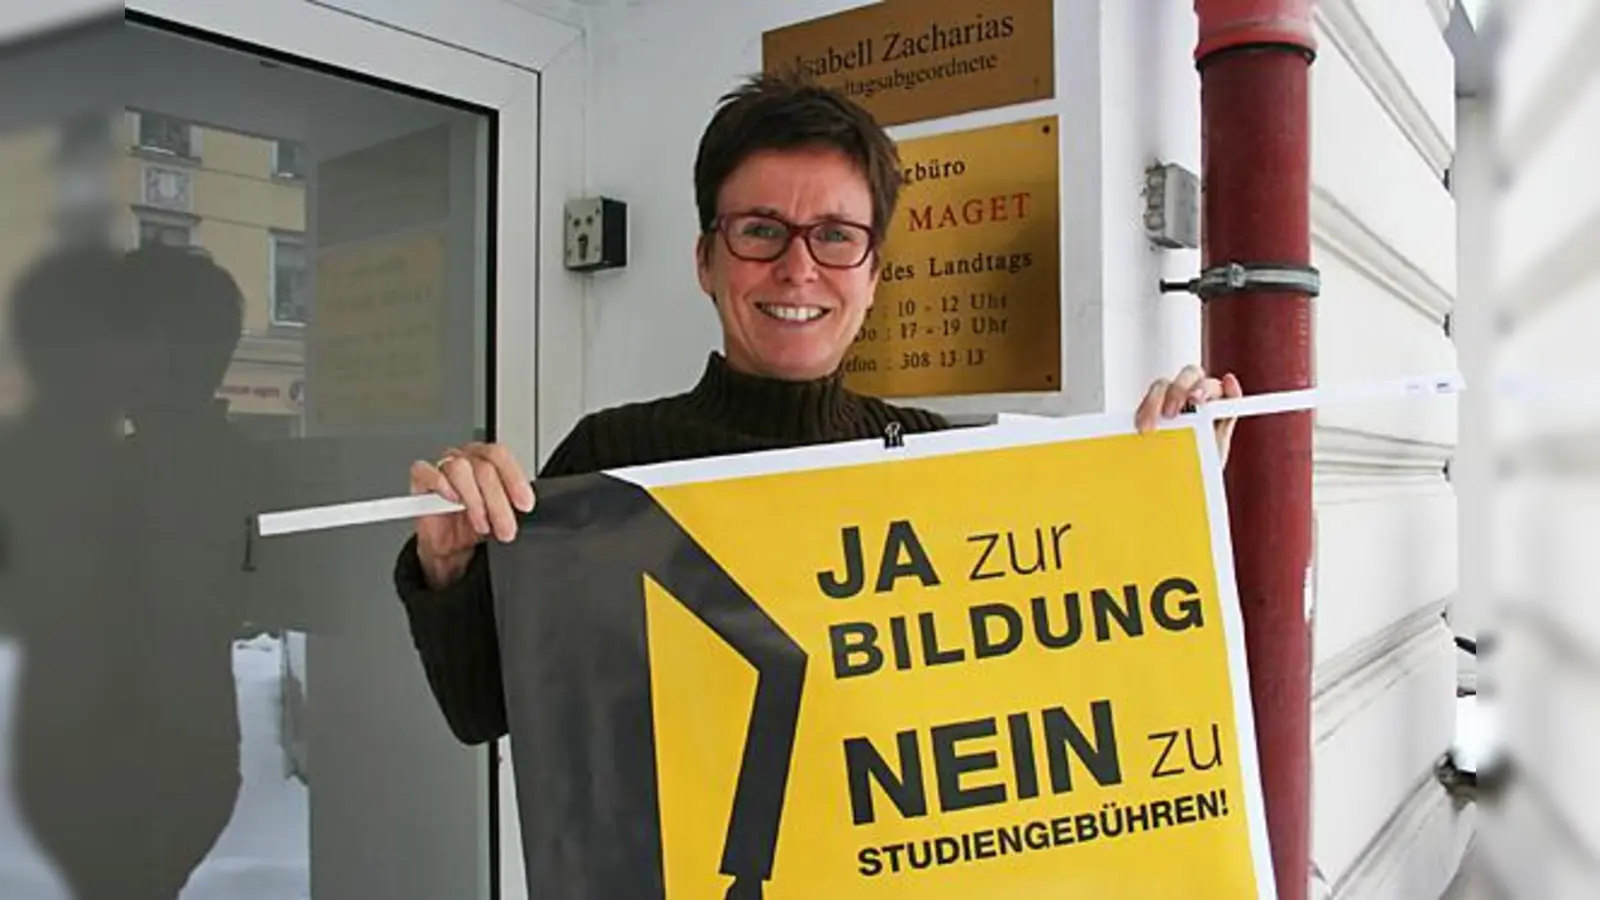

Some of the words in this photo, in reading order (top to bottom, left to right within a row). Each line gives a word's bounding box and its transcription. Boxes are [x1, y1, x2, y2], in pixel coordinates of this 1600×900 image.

[881, 14, 1014, 63] Zacharias
[908, 192, 1031, 232] MAGET
[881, 261, 915, 282] des
[929, 252, 1033, 278] Landtags
[898, 299, 916, 317] 10
[941, 295, 959, 313] 12
[970, 292, 1007, 311] Uhr
[901, 322, 918, 339] 17
[943, 318, 961, 336] 19
[971, 316, 1007, 335] Uhr
[900, 350, 931, 370] 308
[816, 519, 941, 599] JA
[967, 522, 1072, 582] zur
[828, 577, 1205, 680] BILDUNG
[842, 699, 1123, 826] NEIN
[1147, 722, 1224, 779] zu
[857, 788, 1230, 877] STUDIENGEBÜHREN!
